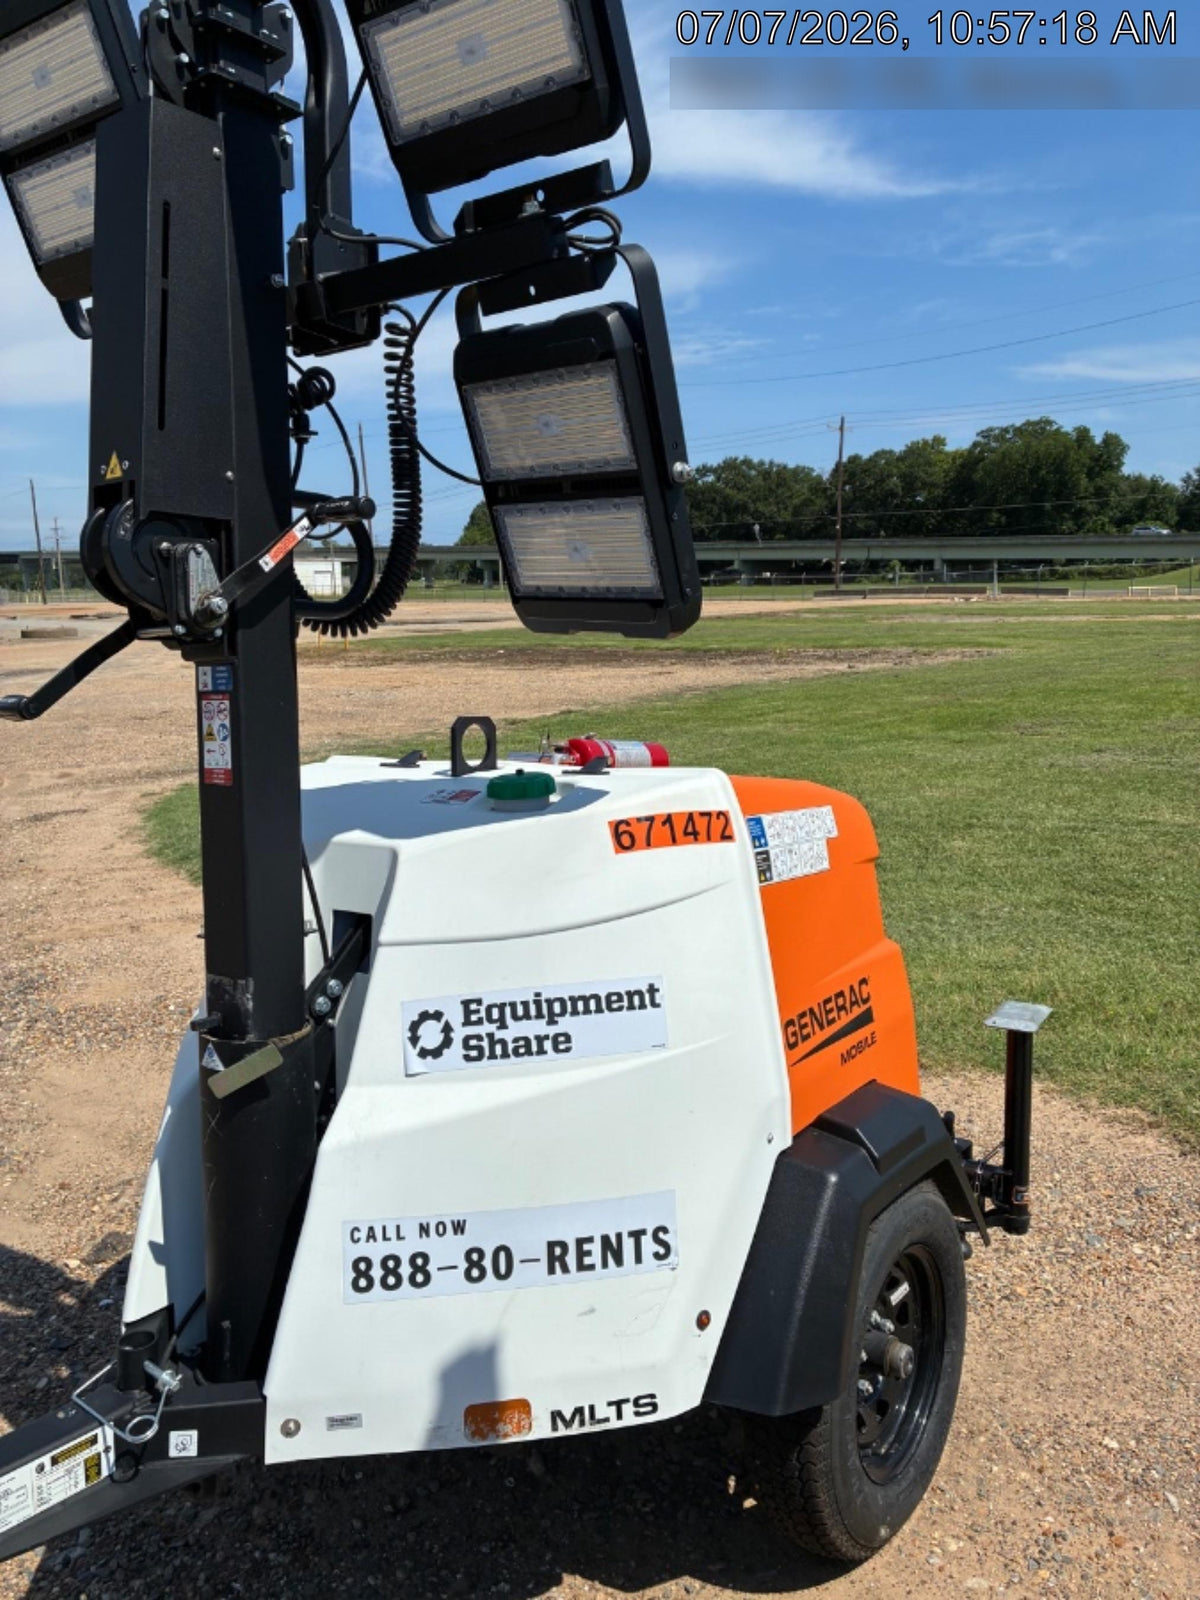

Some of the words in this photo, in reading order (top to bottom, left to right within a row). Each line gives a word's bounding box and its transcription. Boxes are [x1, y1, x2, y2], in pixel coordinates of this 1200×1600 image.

[614, 811, 734, 851] 671472
[460, 983, 662, 1031] Equipment
[784, 977, 871, 1051] GENERAC
[461, 1031, 573, 1063] Share
[840, 1030, 877, 1066] MOBILE
[350, 1224, 406, 1243] CALL
[418, 1219, 468, 1239] NOW
[351, 1225, 672, 1294] 888-80-RENTS
[550, 1393, 659, 1432] MLTS
